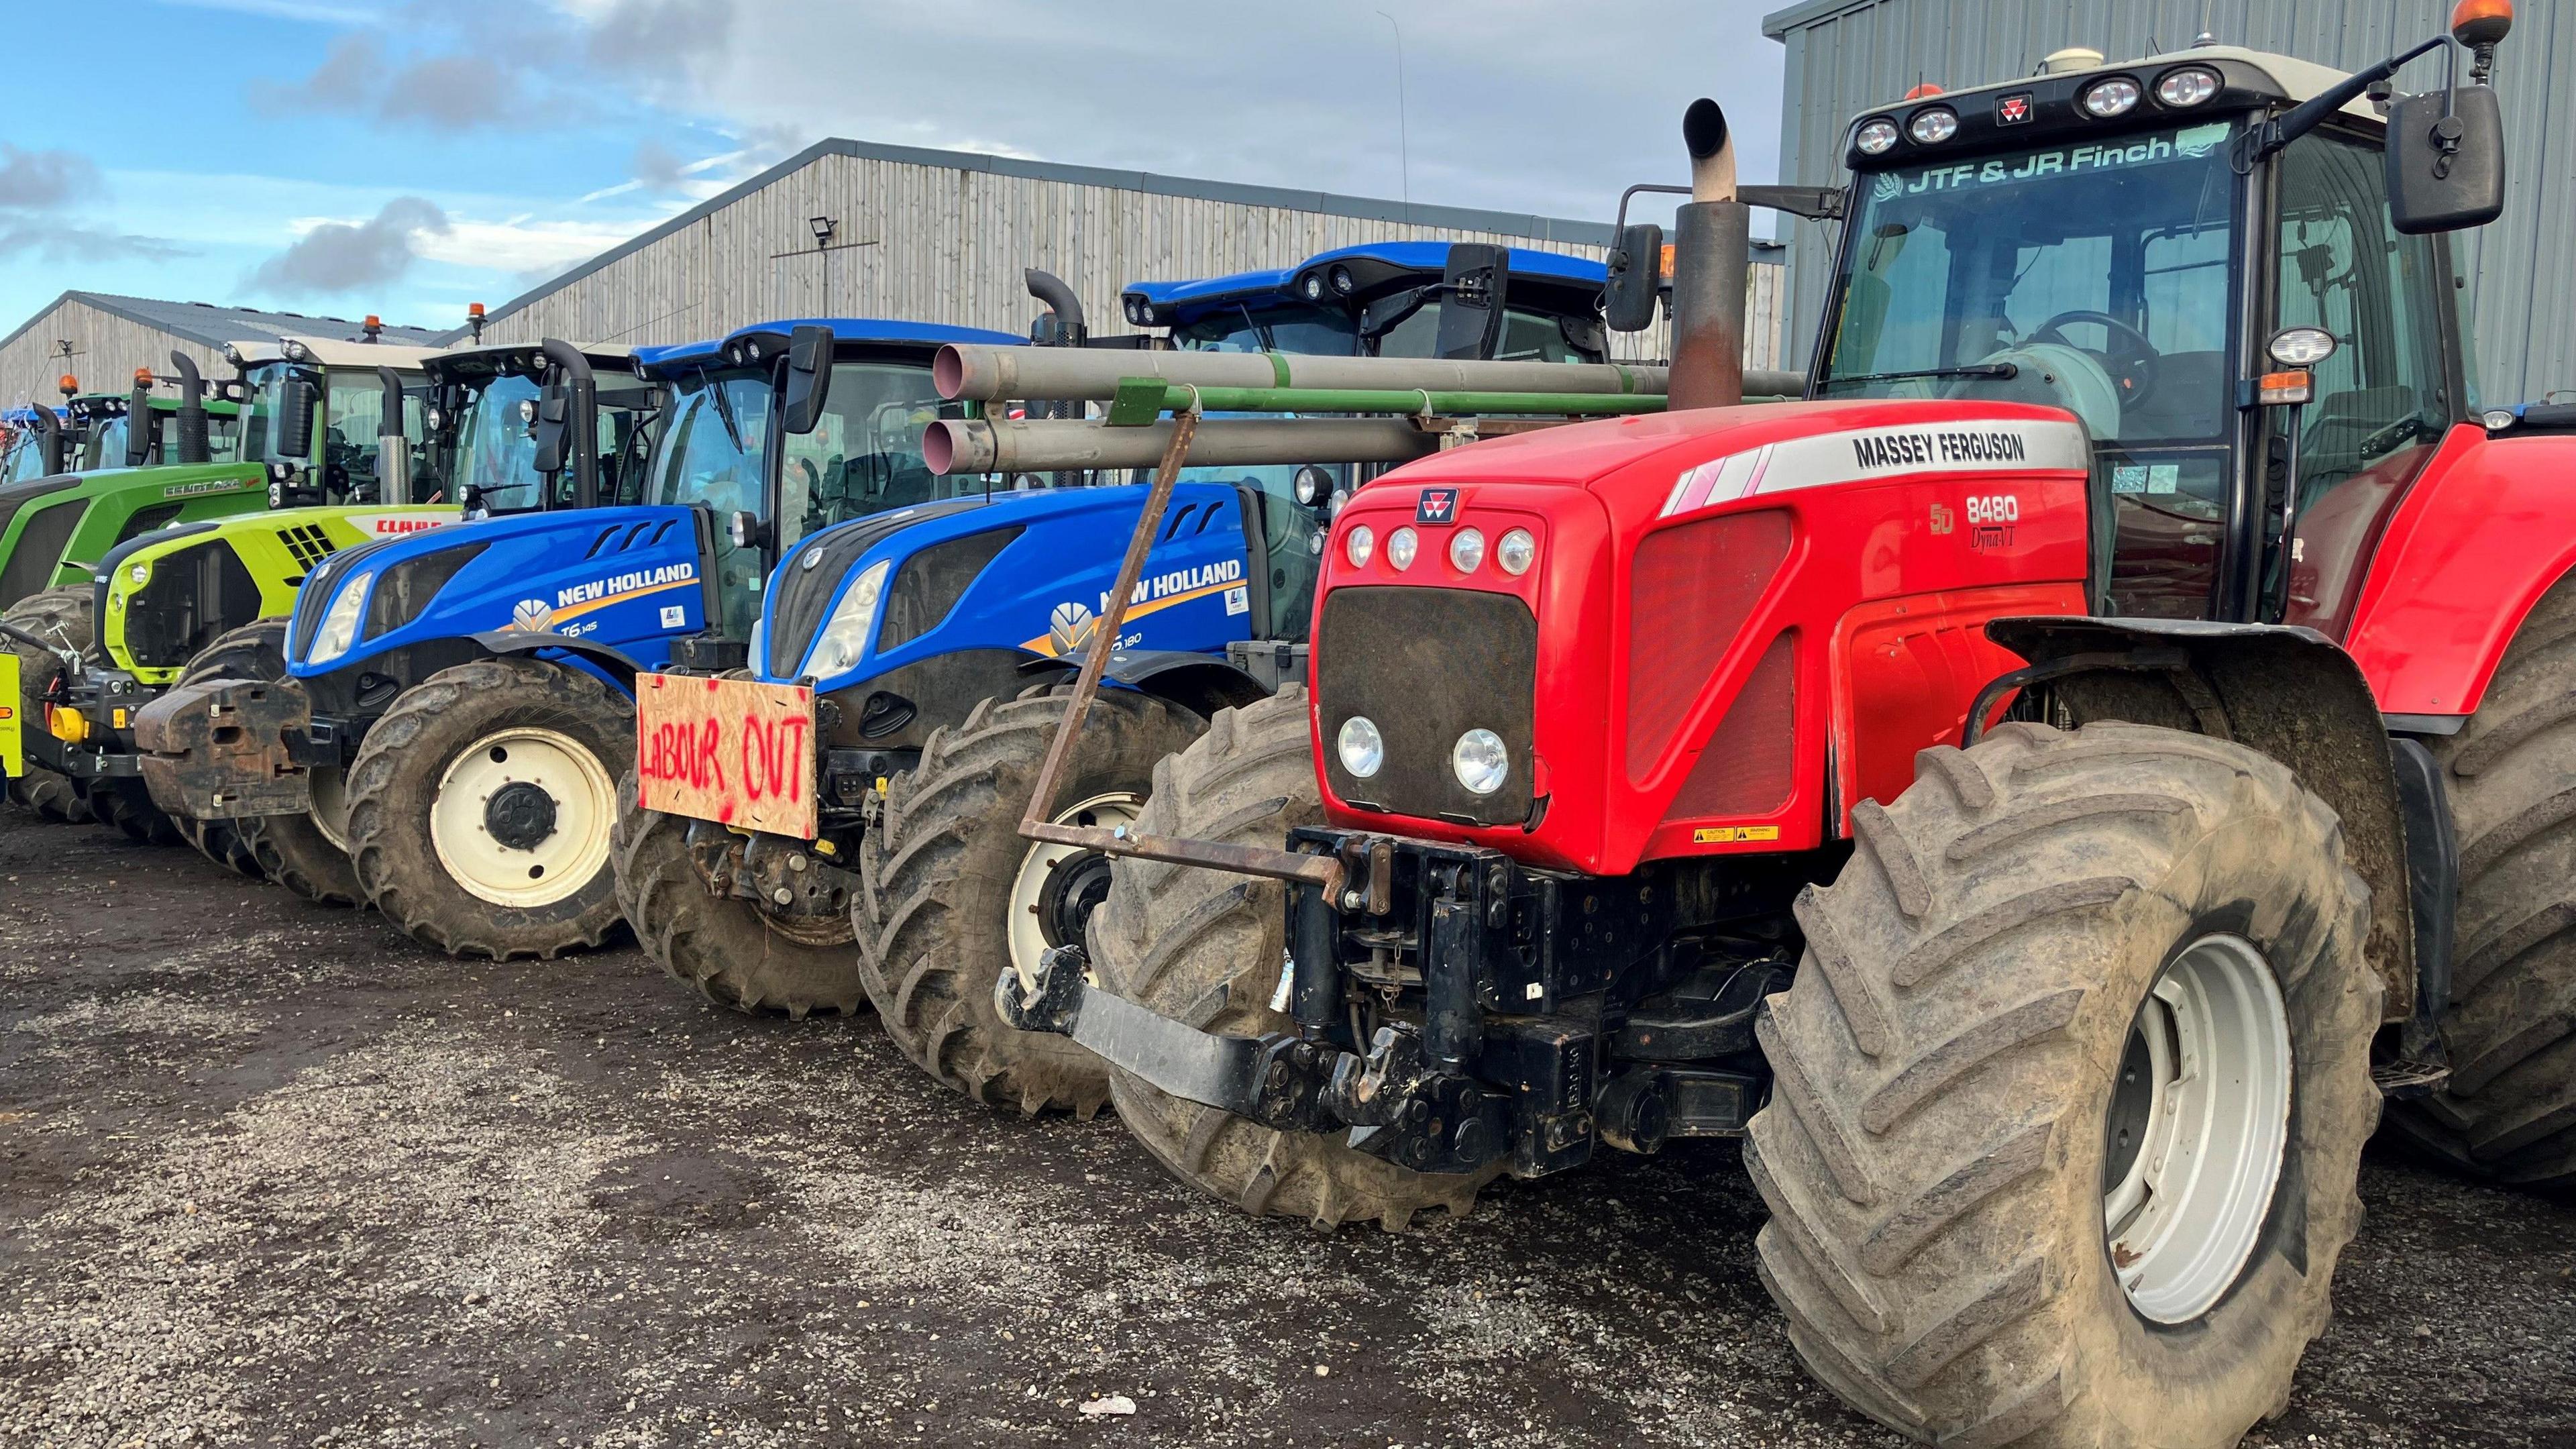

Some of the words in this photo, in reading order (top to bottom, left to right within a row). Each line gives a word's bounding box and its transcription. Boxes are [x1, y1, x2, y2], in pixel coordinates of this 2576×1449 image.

[1908, 164, 1974, 194] JTF
[1979, 160, 2006, 183] &
[2013, 152, 2064, 179] JR
[2070, 137, 2170, 171] Finch
[1852, 433, 1934, 469] MASSEY
[1937, 433, 2025, 462] FERGUSON
[1966, 496, 2019, 523] 8480
[557, 580, 604, 607] NEW
[608, 563, 693, 595] HOLLAND
[1100, 579, 1149, 613] NW
[1153, 559, 1240, 598] HOLLAND
[639, 704, 725, 792] LABOUR
[743, 712, 808, 804] OUT
